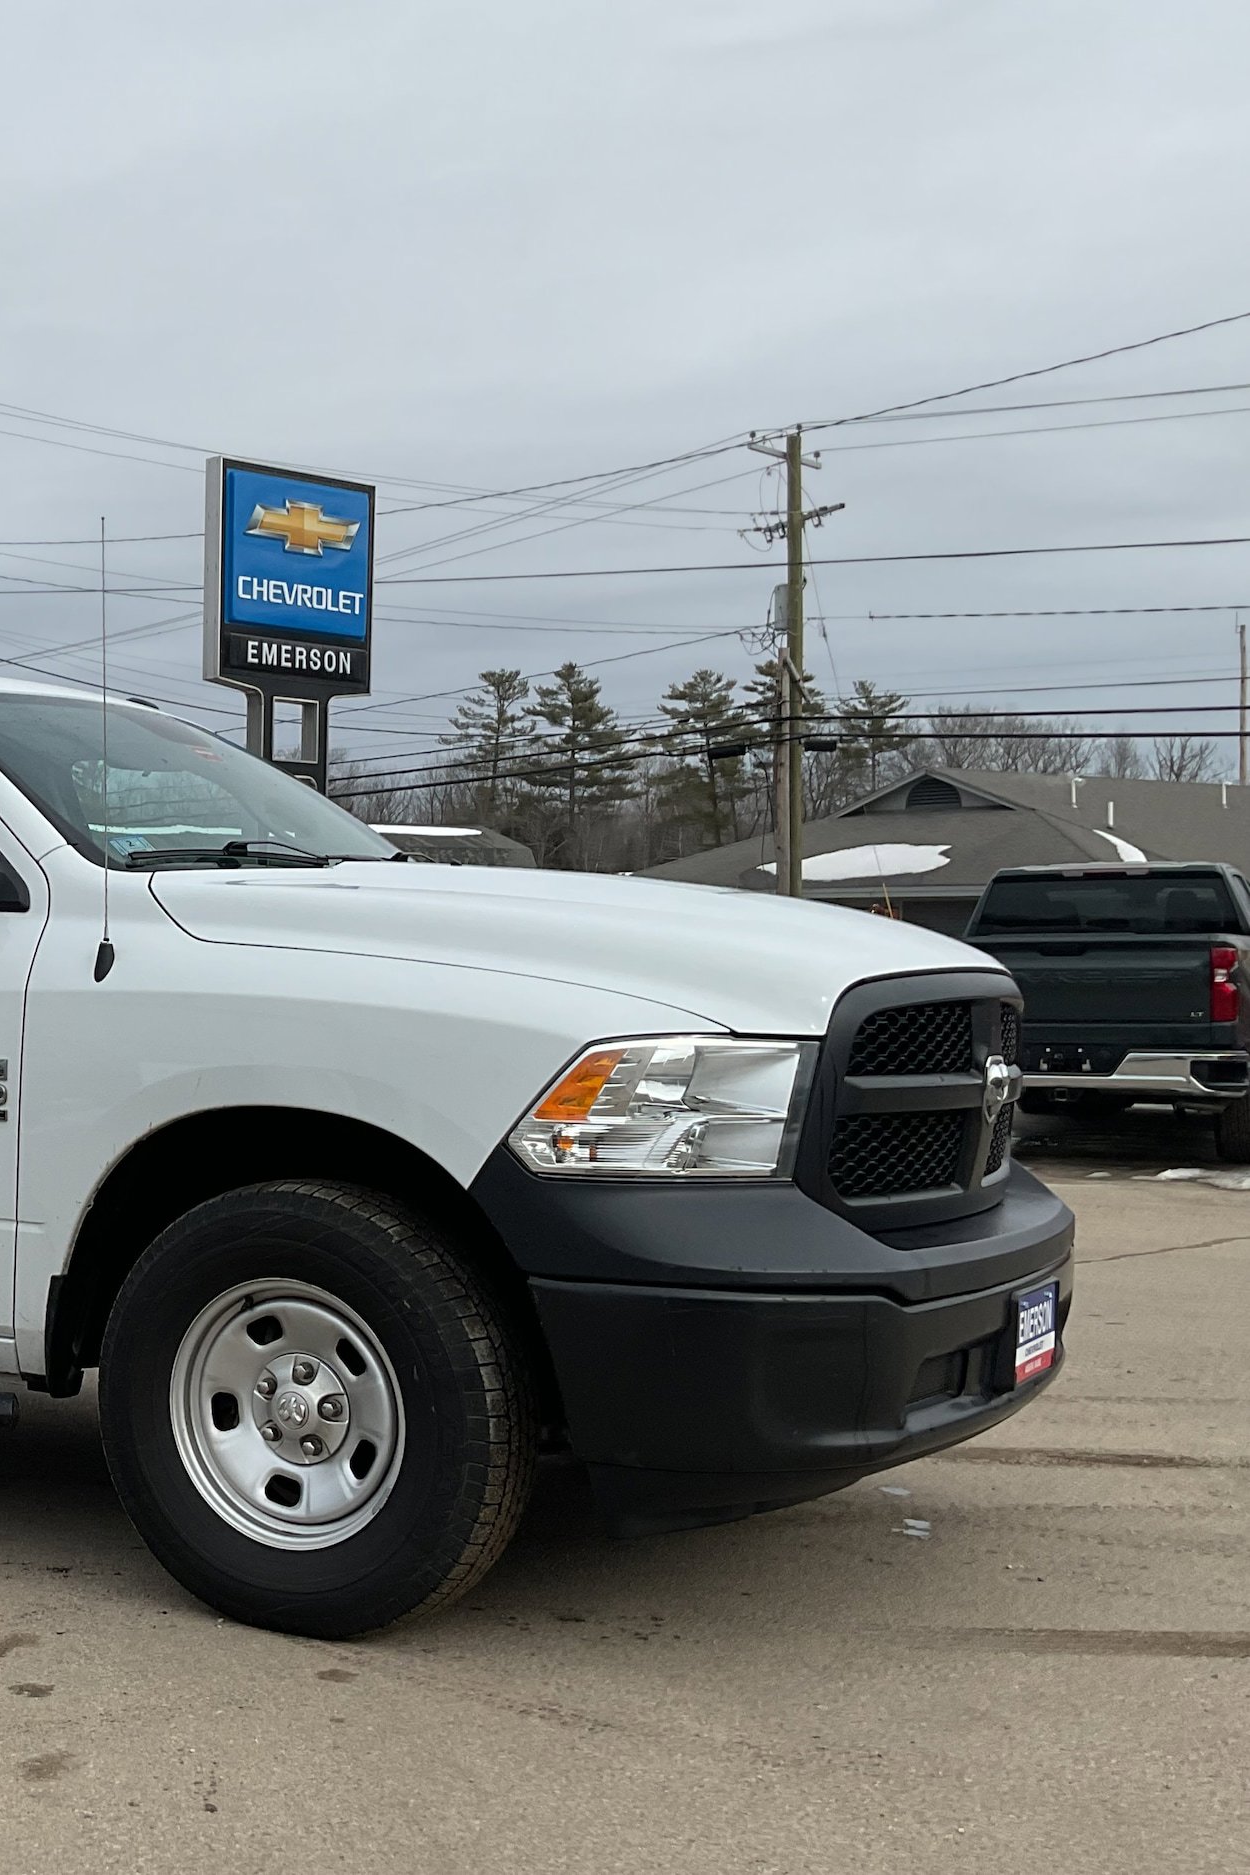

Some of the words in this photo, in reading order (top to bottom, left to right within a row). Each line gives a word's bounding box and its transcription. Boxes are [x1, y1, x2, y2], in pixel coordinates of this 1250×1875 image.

[237, 575, 364, 615] CHEVROLET
[246, 640, 352, 675] EMERSON
[1018, 1299, 1053, 1344] EMERSON
